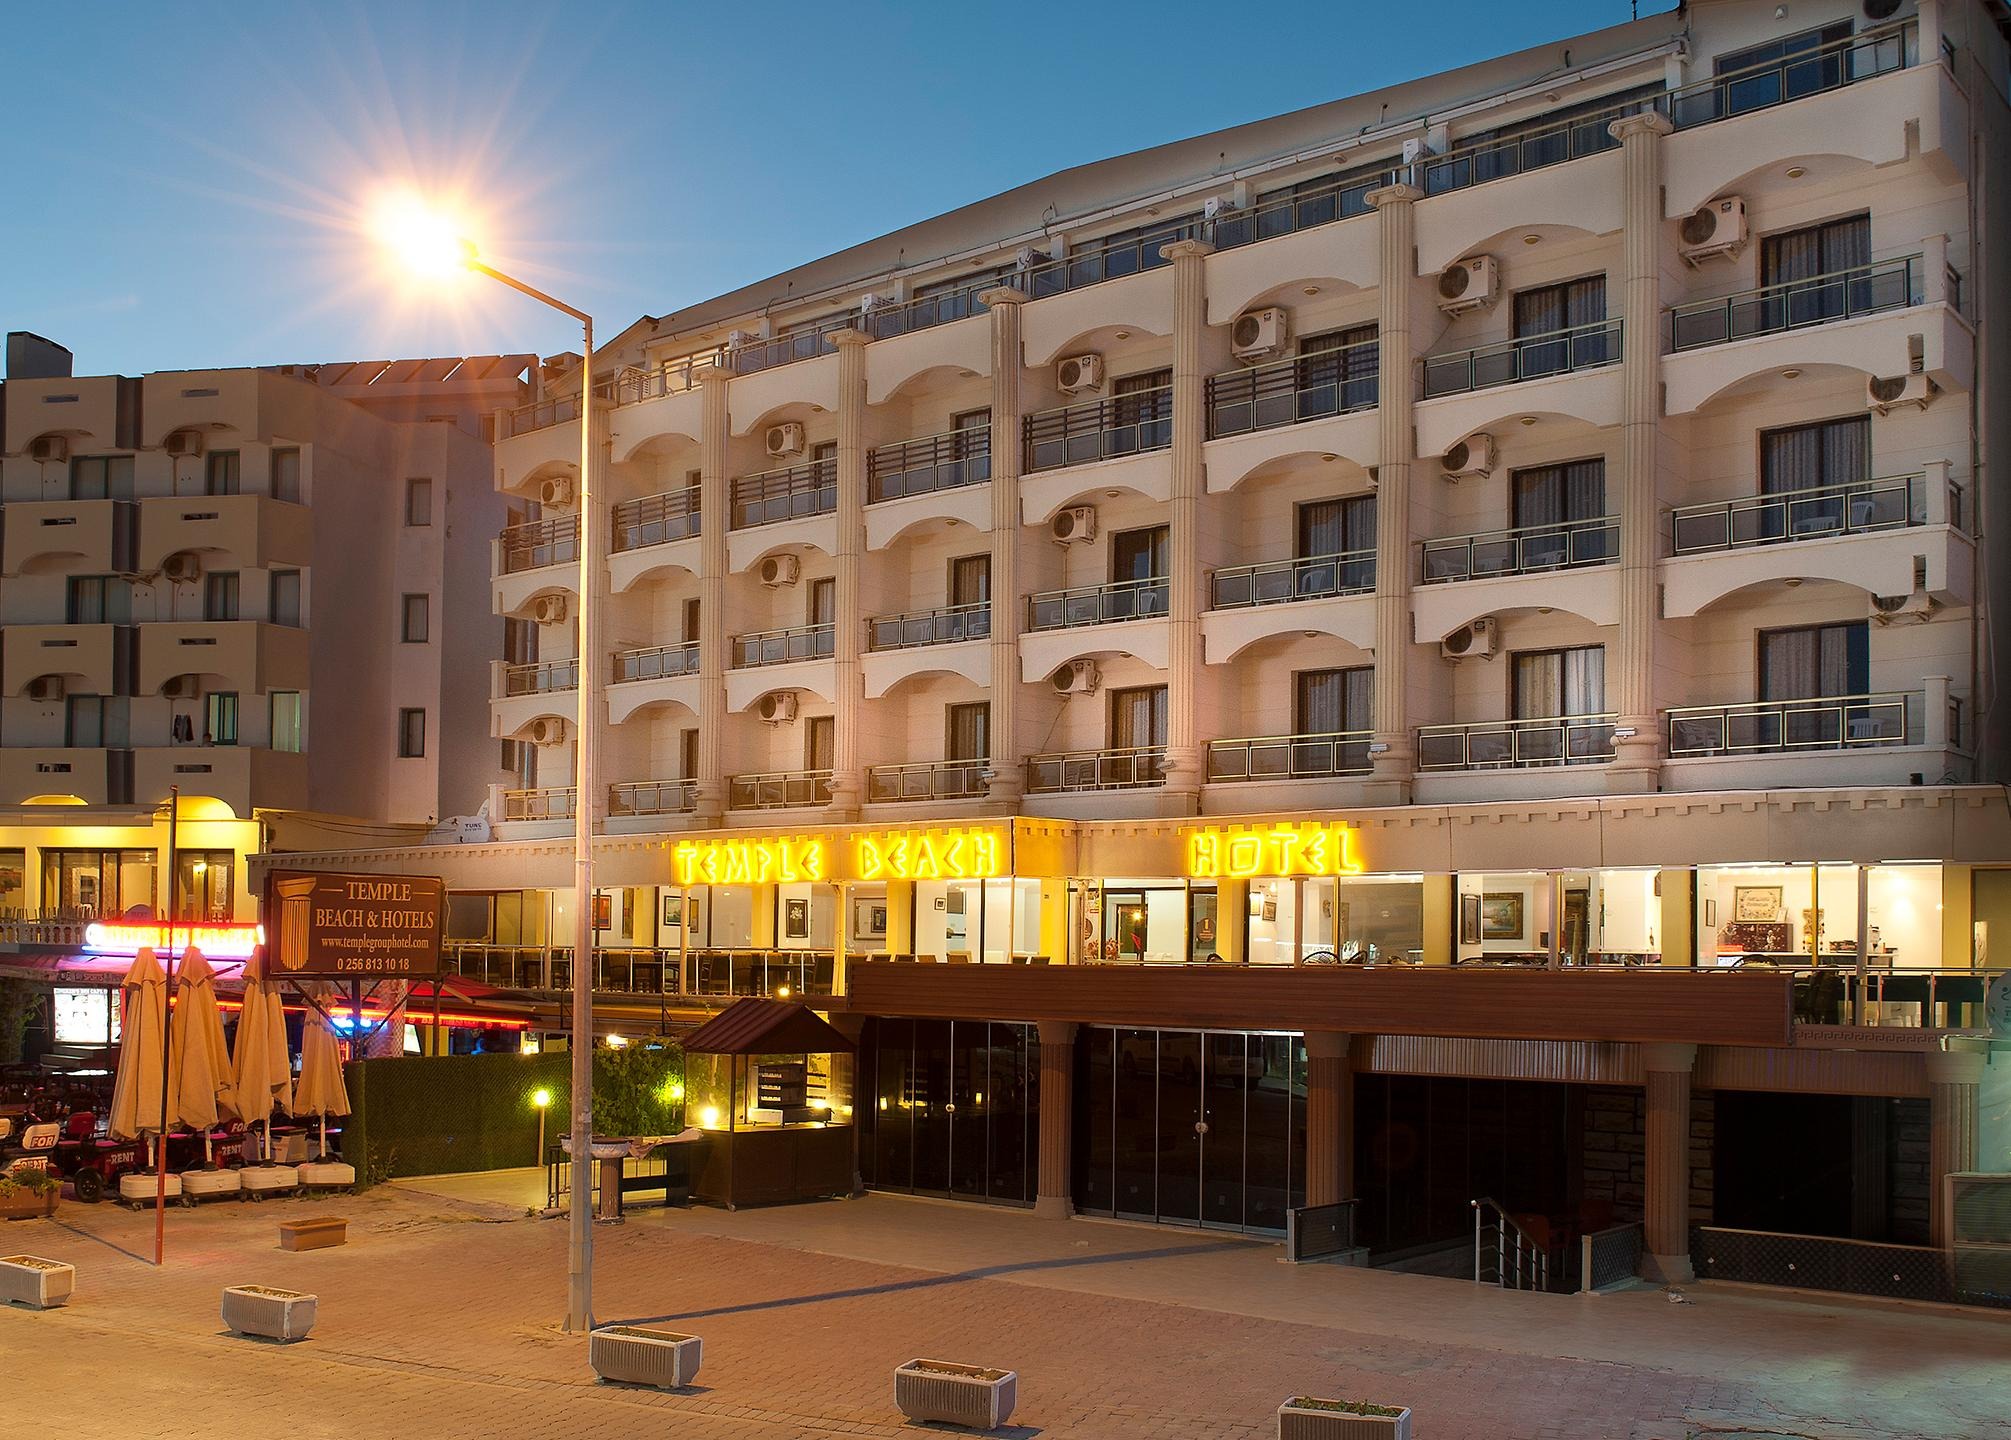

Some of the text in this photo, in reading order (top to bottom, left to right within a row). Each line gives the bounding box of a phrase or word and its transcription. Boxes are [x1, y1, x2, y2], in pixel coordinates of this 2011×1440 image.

[677, 831, 1362, 883] TEMPLE BEACH HOTEL
[346, 881, 411, 901] TEMPLE
[315, 909, 434, 928] BEACH & HOTELS
[321, 933, 429, 952] www.templegrouphotel.com
[337, 958, 410, 970] 0 256 813 10 18
[31, 1135, 55, 1148] FOR
[111, 1151, 135, 1165] RENT
